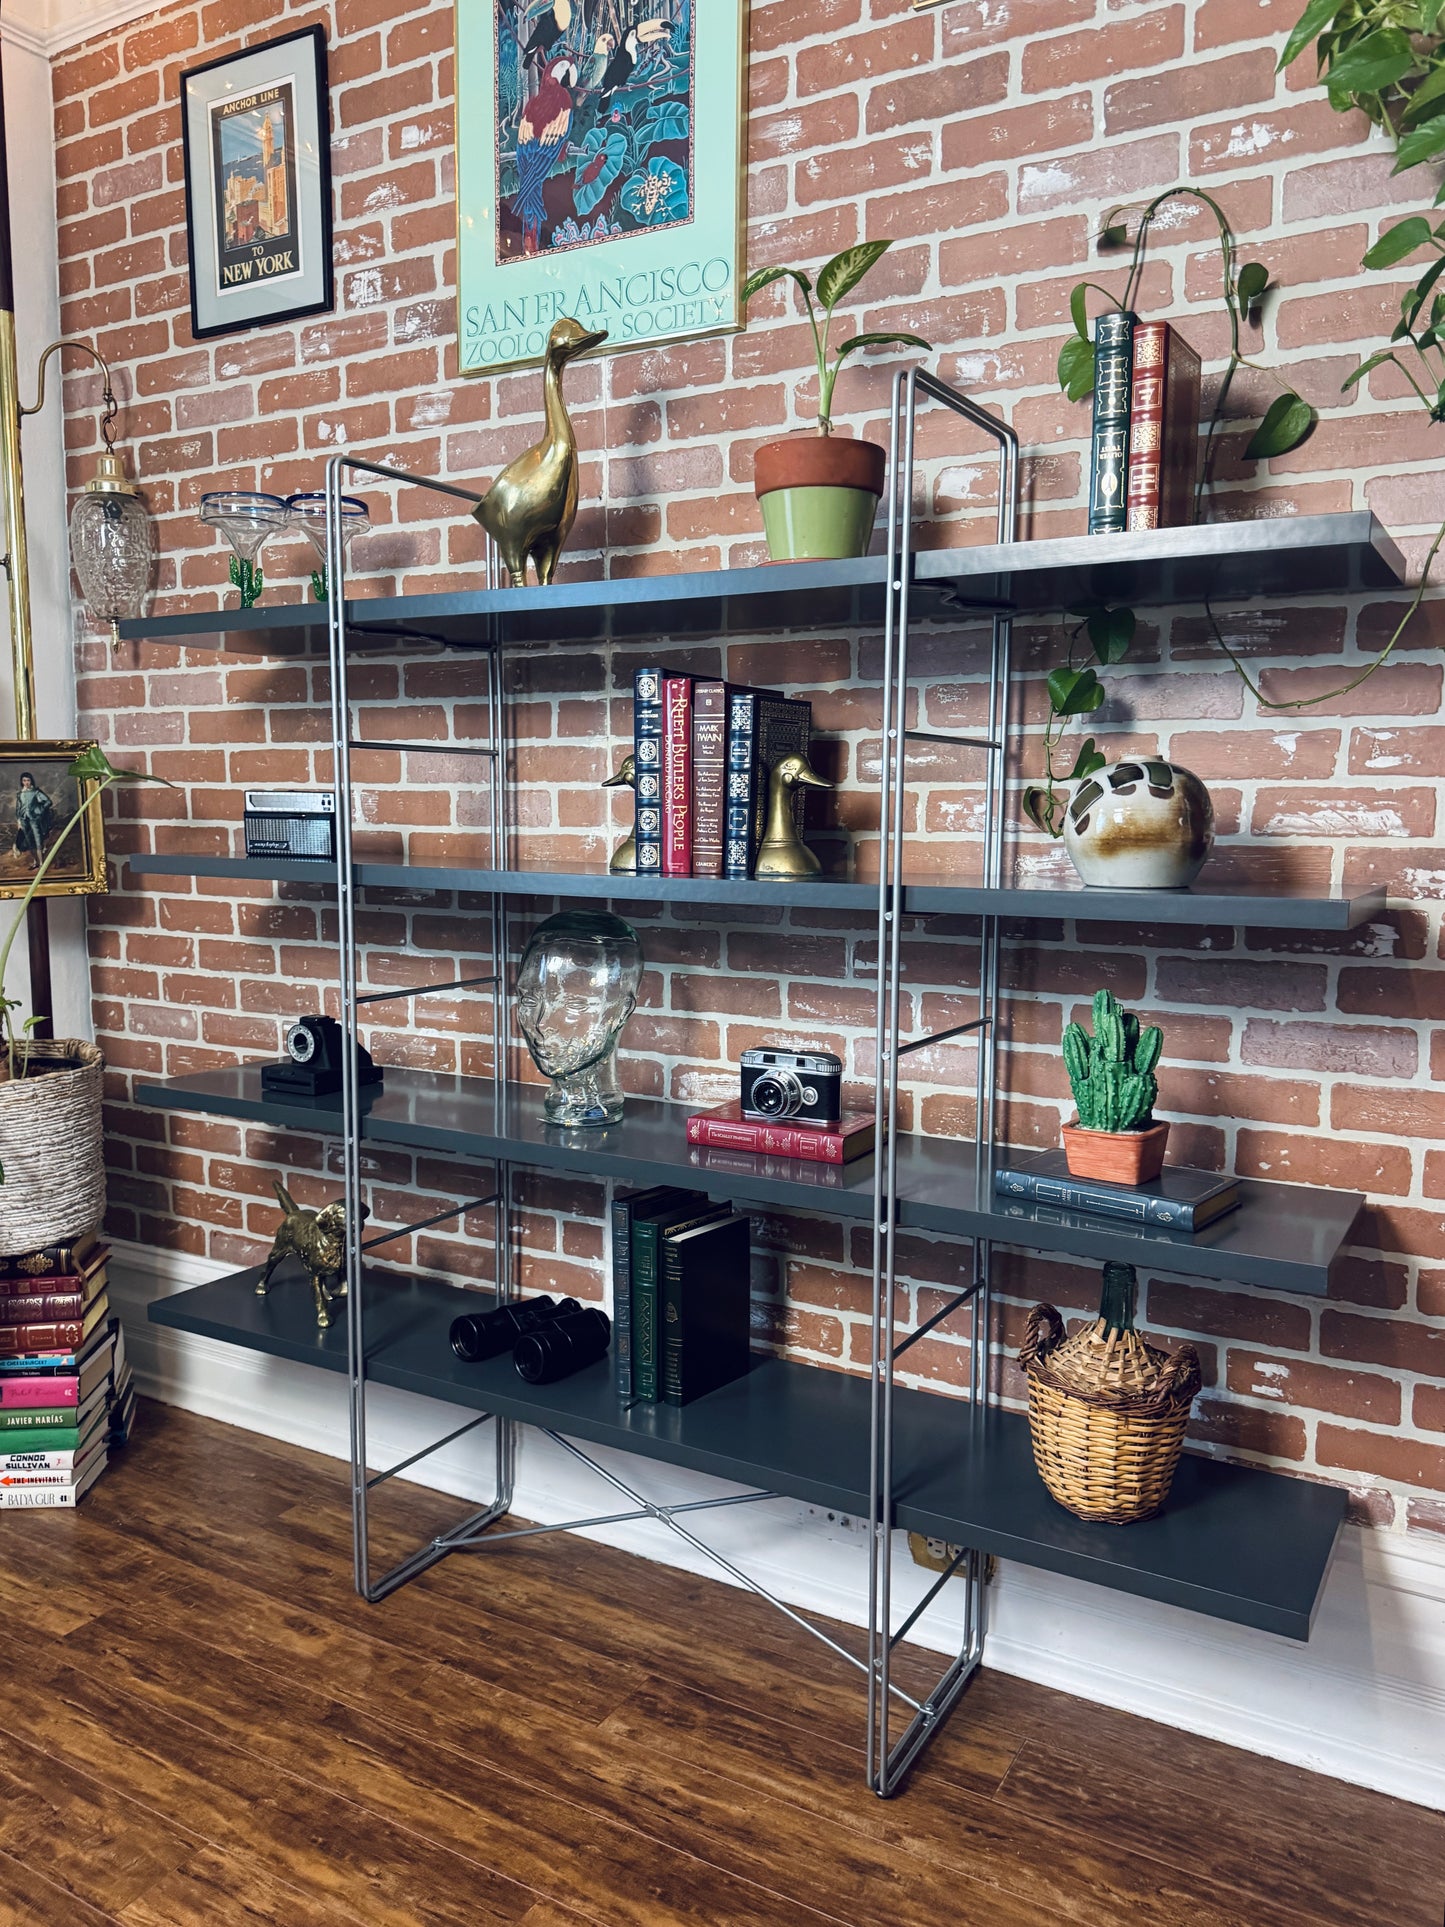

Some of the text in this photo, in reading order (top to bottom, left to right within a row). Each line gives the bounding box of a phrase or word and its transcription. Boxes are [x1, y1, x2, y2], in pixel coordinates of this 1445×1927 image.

[223, 88, 280, 115] ANCHOR LINE
[252, 245, 264, 257] TO
[223, 251, 294, 284] NEW YORK
[466, 256, 731, 338] SAN FRANCISCO
[466, 298, 727, 366] ZOOLOAL SOCIETY
[697, 733, 722, 742] TWAIN
[665, 735, 673, 774] DONALD
[672, 805, 688, 852] PEOPLE
[7, 1414, 64, 1426] JAVIER MARÍAS
[28, 1476, 64, 1484] INEVITABLE
[8, 1493, 55, 1506] BATYA GUR
